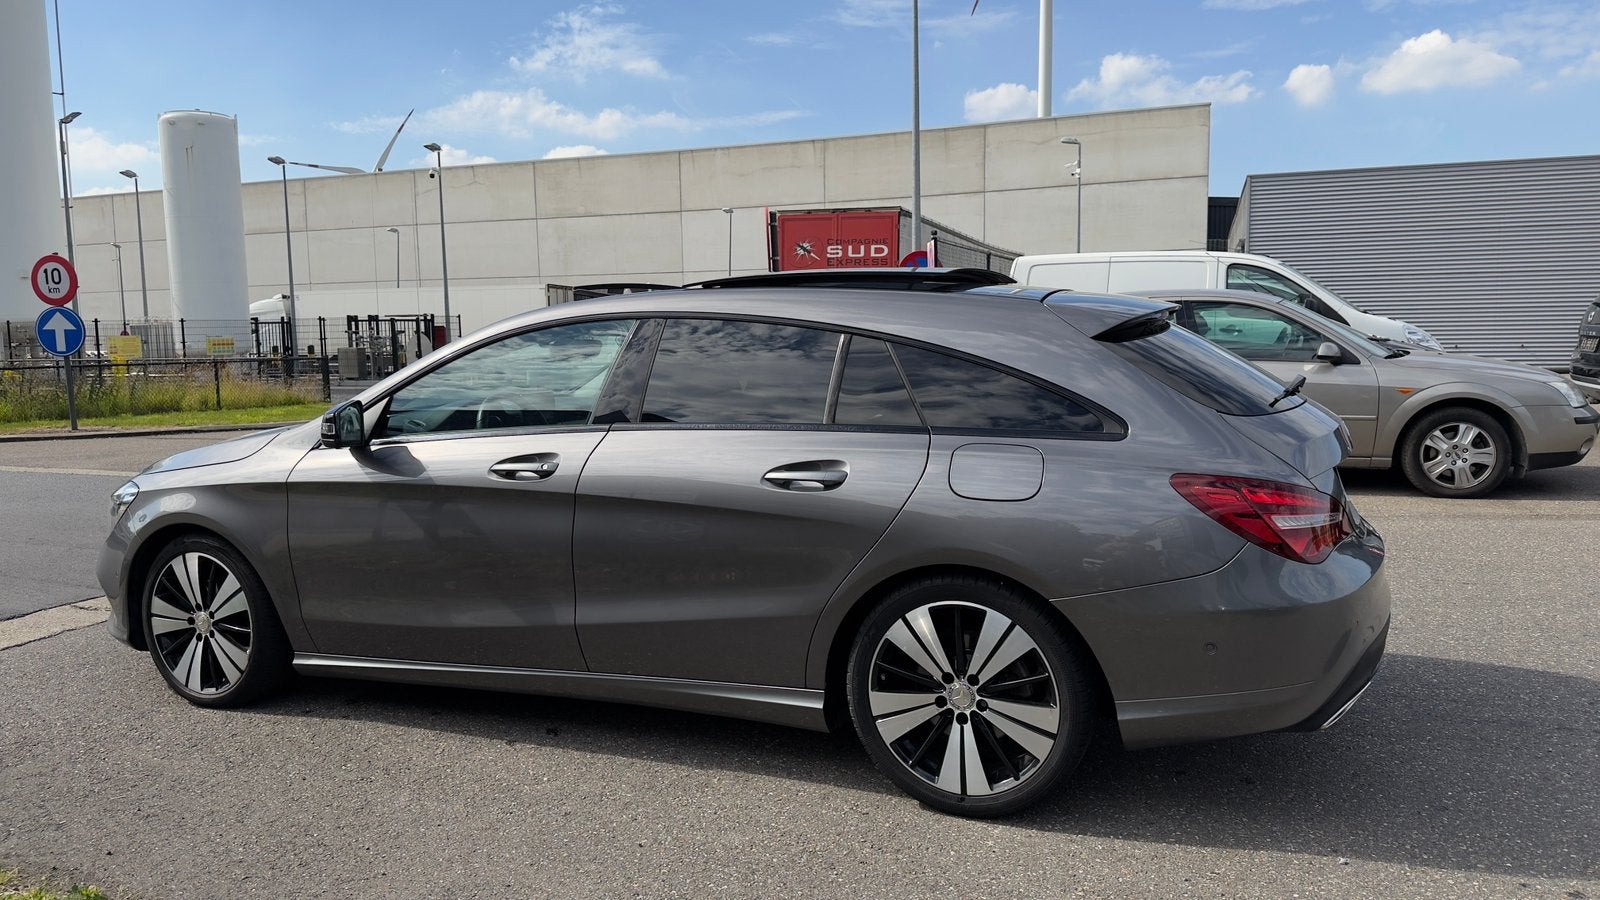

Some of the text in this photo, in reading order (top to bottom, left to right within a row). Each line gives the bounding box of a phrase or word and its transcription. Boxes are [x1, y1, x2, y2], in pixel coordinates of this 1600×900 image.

[826, 244, 889, 258] SUD
[827, 258, 888, 266] EXPRESS
[43, 267, 62, 285] 10
[47, 286, 60, 294] km
